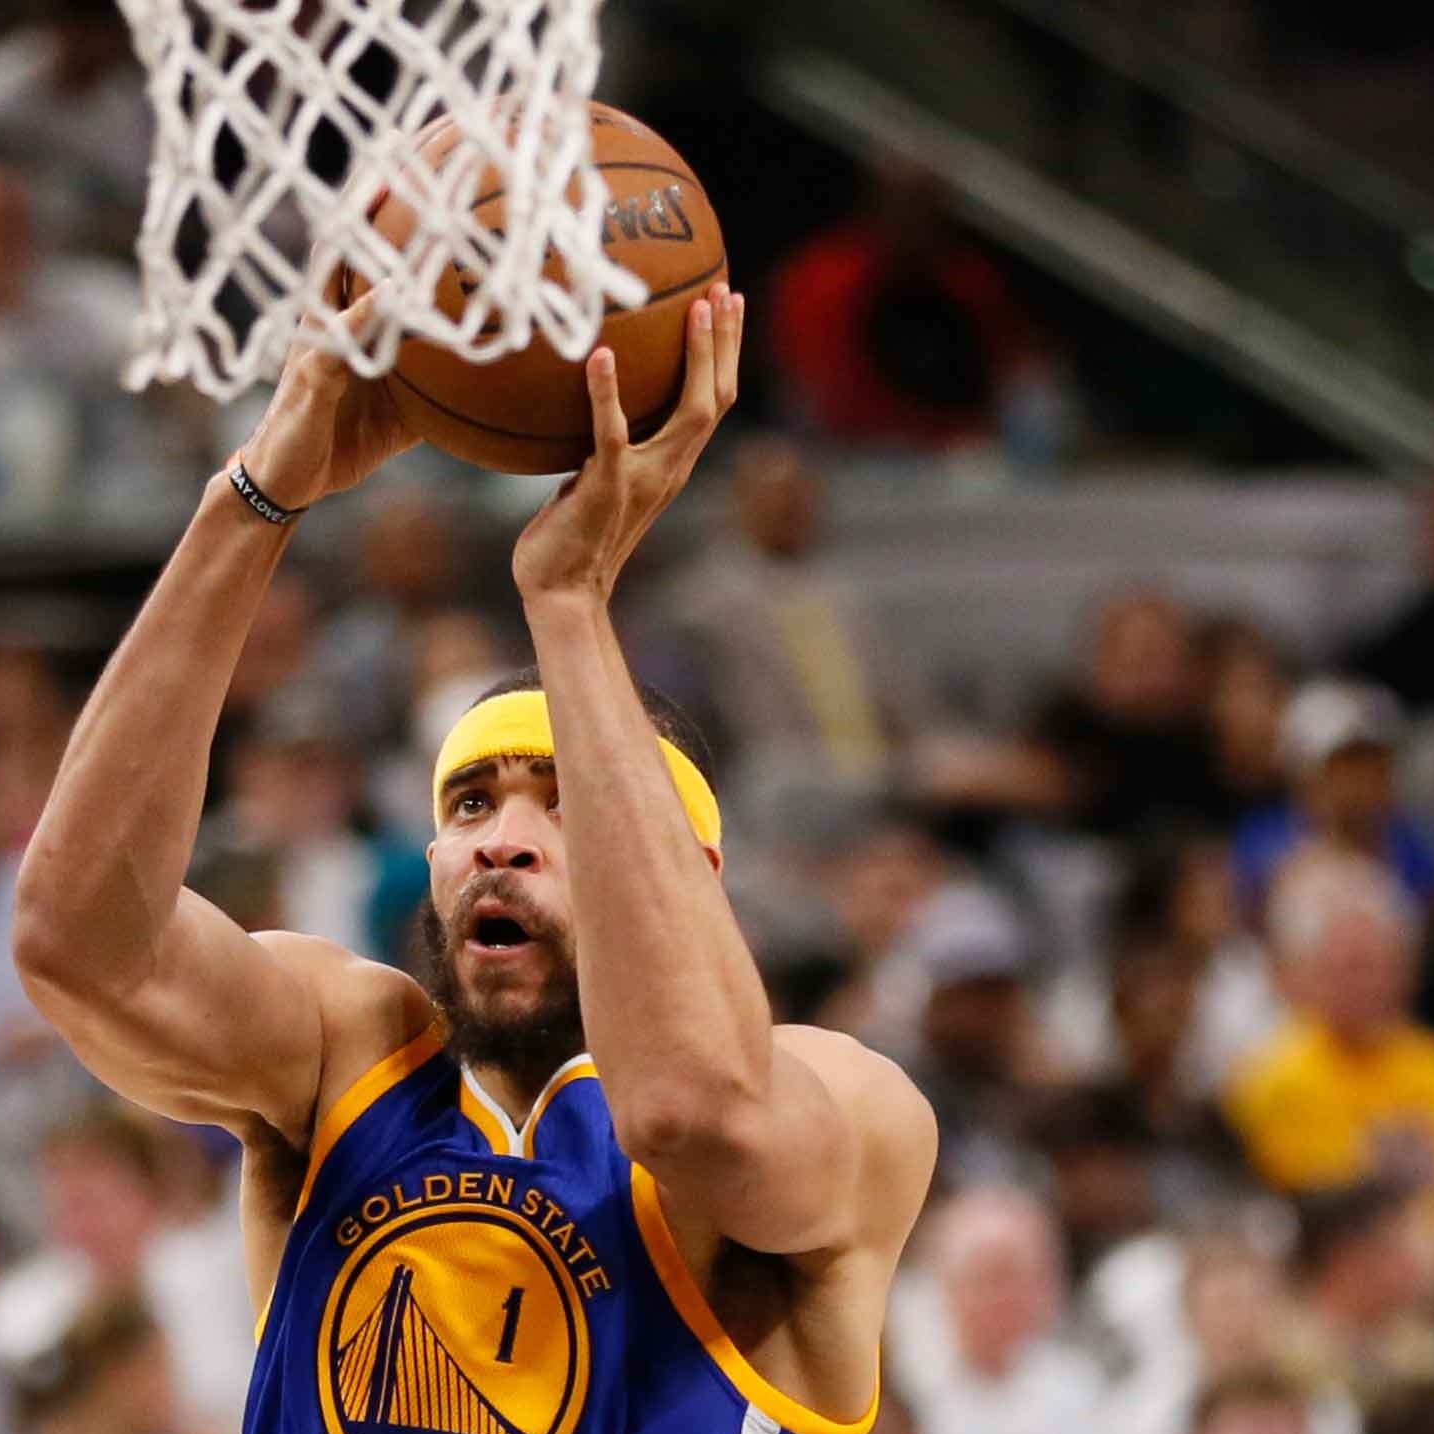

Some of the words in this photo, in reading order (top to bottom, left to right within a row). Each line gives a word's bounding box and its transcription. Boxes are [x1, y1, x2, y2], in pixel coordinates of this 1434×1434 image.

[336, 1172, 515, 1247] GOLDEN
[524, 1188, 612, 1299] STATE
[494, 1286, 525, 1364] 1
